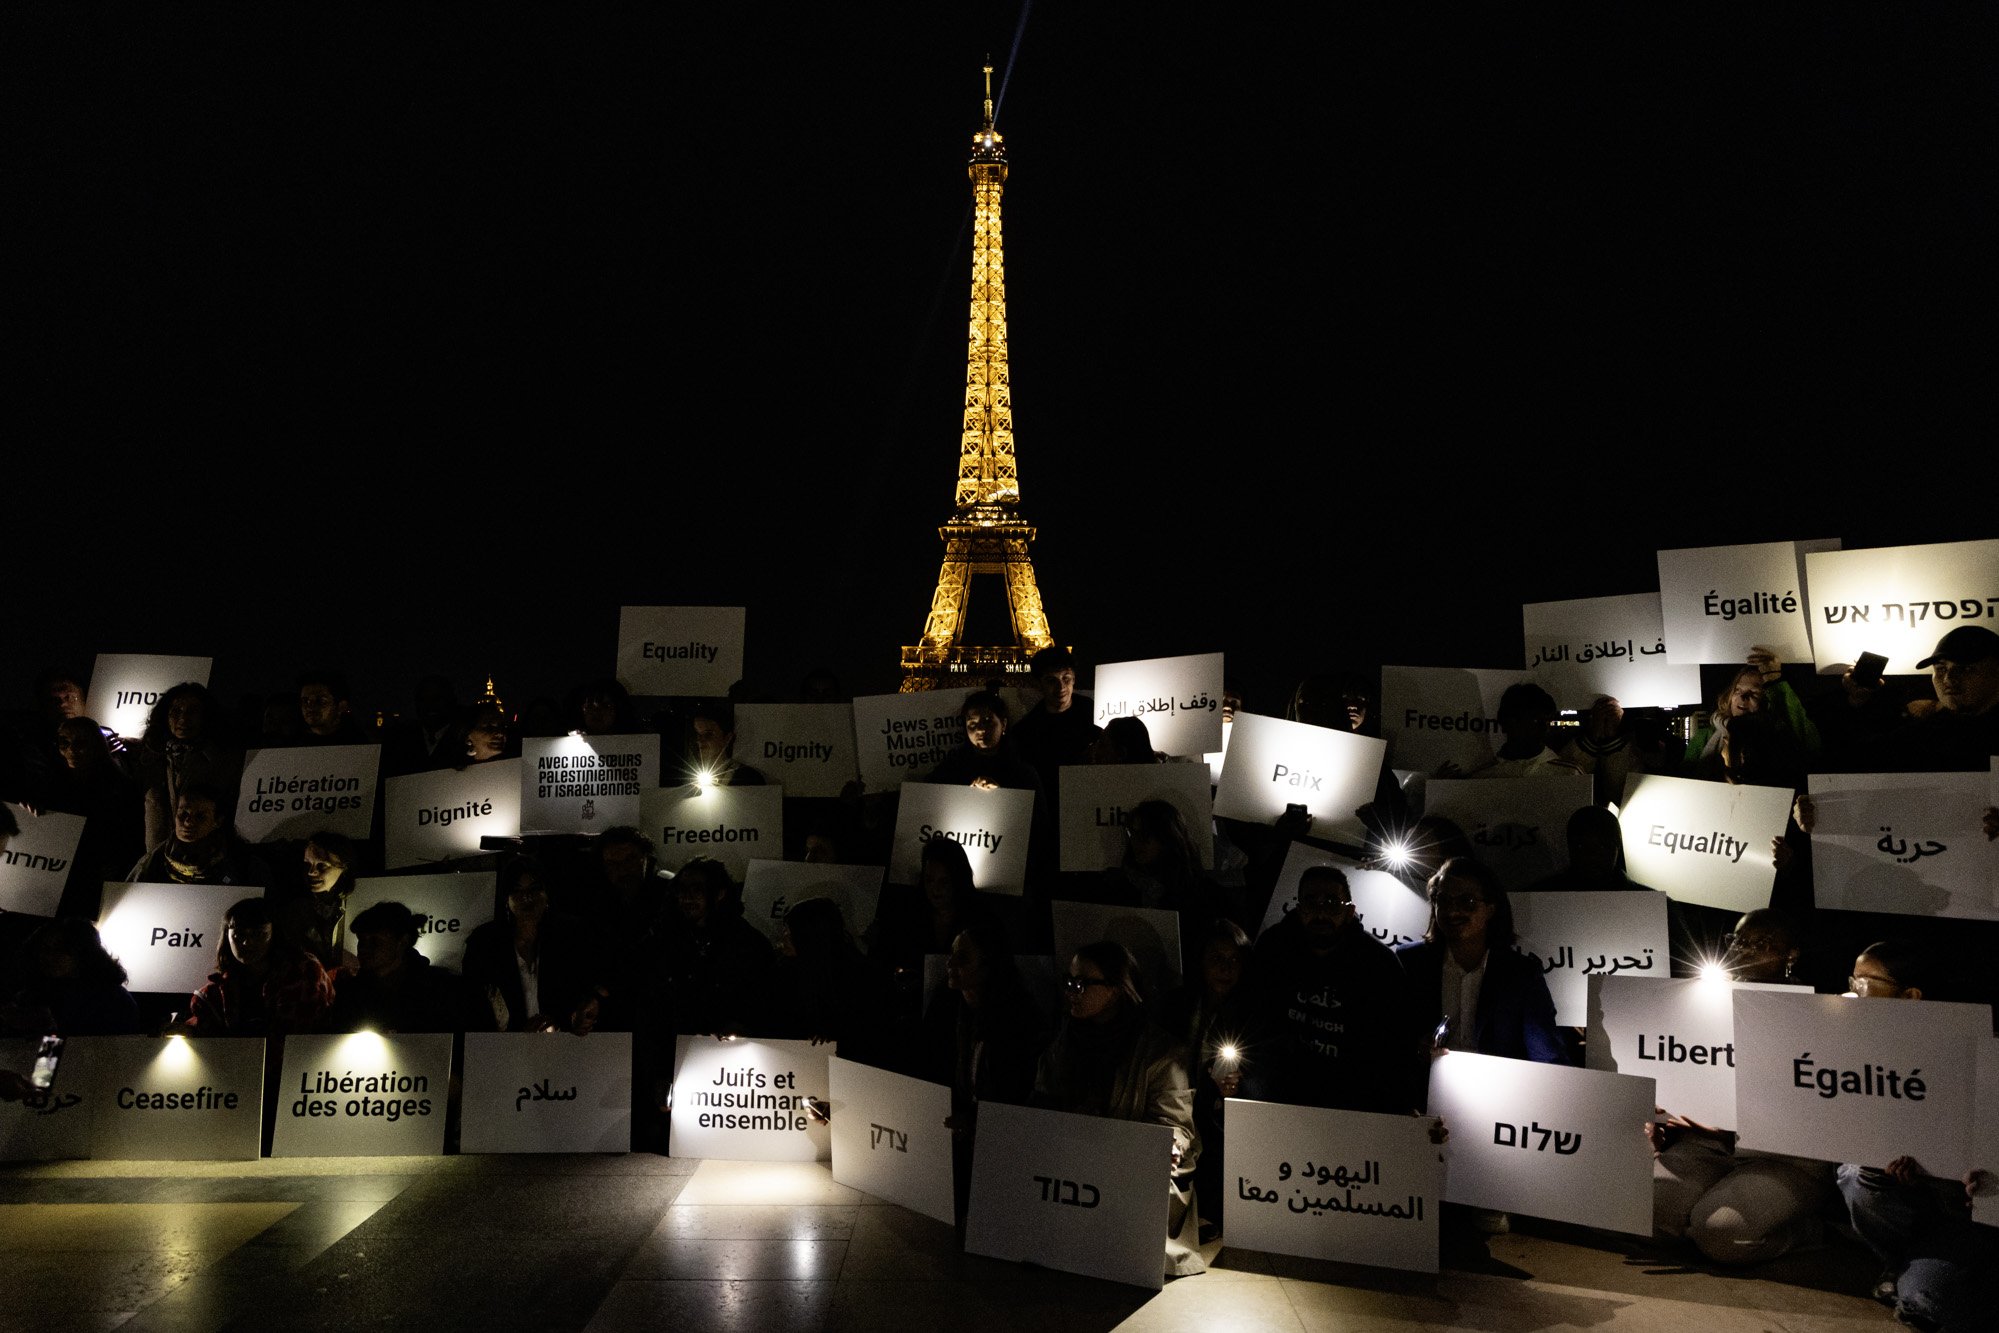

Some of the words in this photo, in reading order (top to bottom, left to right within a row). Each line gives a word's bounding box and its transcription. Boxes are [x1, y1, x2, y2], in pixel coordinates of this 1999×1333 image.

[1704, 590, 1797, 621] Égalité
[1824, 604, 1870, 625] אש
[642, 641, 719, 663] Equality
[1531, 645, 1570, 668] النار
[1575, 640, 1635, 664] إطلاق
[116, 690, 167, 709] טחון
[1180, 692, 1217, 712] وقف
[881, 718, 928, 735] Jews
[763, 741, 834, 763] Dignity
[886, 731, 966, 750] Muslims
[888, 747, 953, 769] togeth
[256, 774, 359, 795] Libération
[1272, 764, 1323, 791] Paix
[248, 794, 289, 813] des
[291, 794, 362, 815] otages
[418, 798, 493, 827] Dignité
[663, 825, 760, 845] Freedom
[918, 824, 1003, 853] Security
[1647, 824, 1748, 861] Equality
[1876, 827, 1947, 863] حرية
[150, 927, 204, 948] Paix
[1638, 1034, 1735, 1068] Libert
[301, 1071, 428, 1094] Libération
[712, 1067, 767, 1087] Juifs
[774, 1071, 796, 1089] et
[1793, 1052, 1927, 1101] Égalité
[117, 1087, 239, 1110] Ceasefire
[515, 1079, 577, 1111] سلام
[292, 1096, 339, 1118] des
[345, 1097, 432, 1121] otages
[698, 1111, 808, 1131] ensemble
[870, 1123, 909, 1153] צדק
[1493, 1122, 1582, 1156] שלום
[1278, 1162, 1293, 1181] و
[1301, 1161, 1380, 1190] اليهود
[1033, 1175, 1101, 1208] כבוד
[1288, 1190, 1424, 1221] المسلمين
